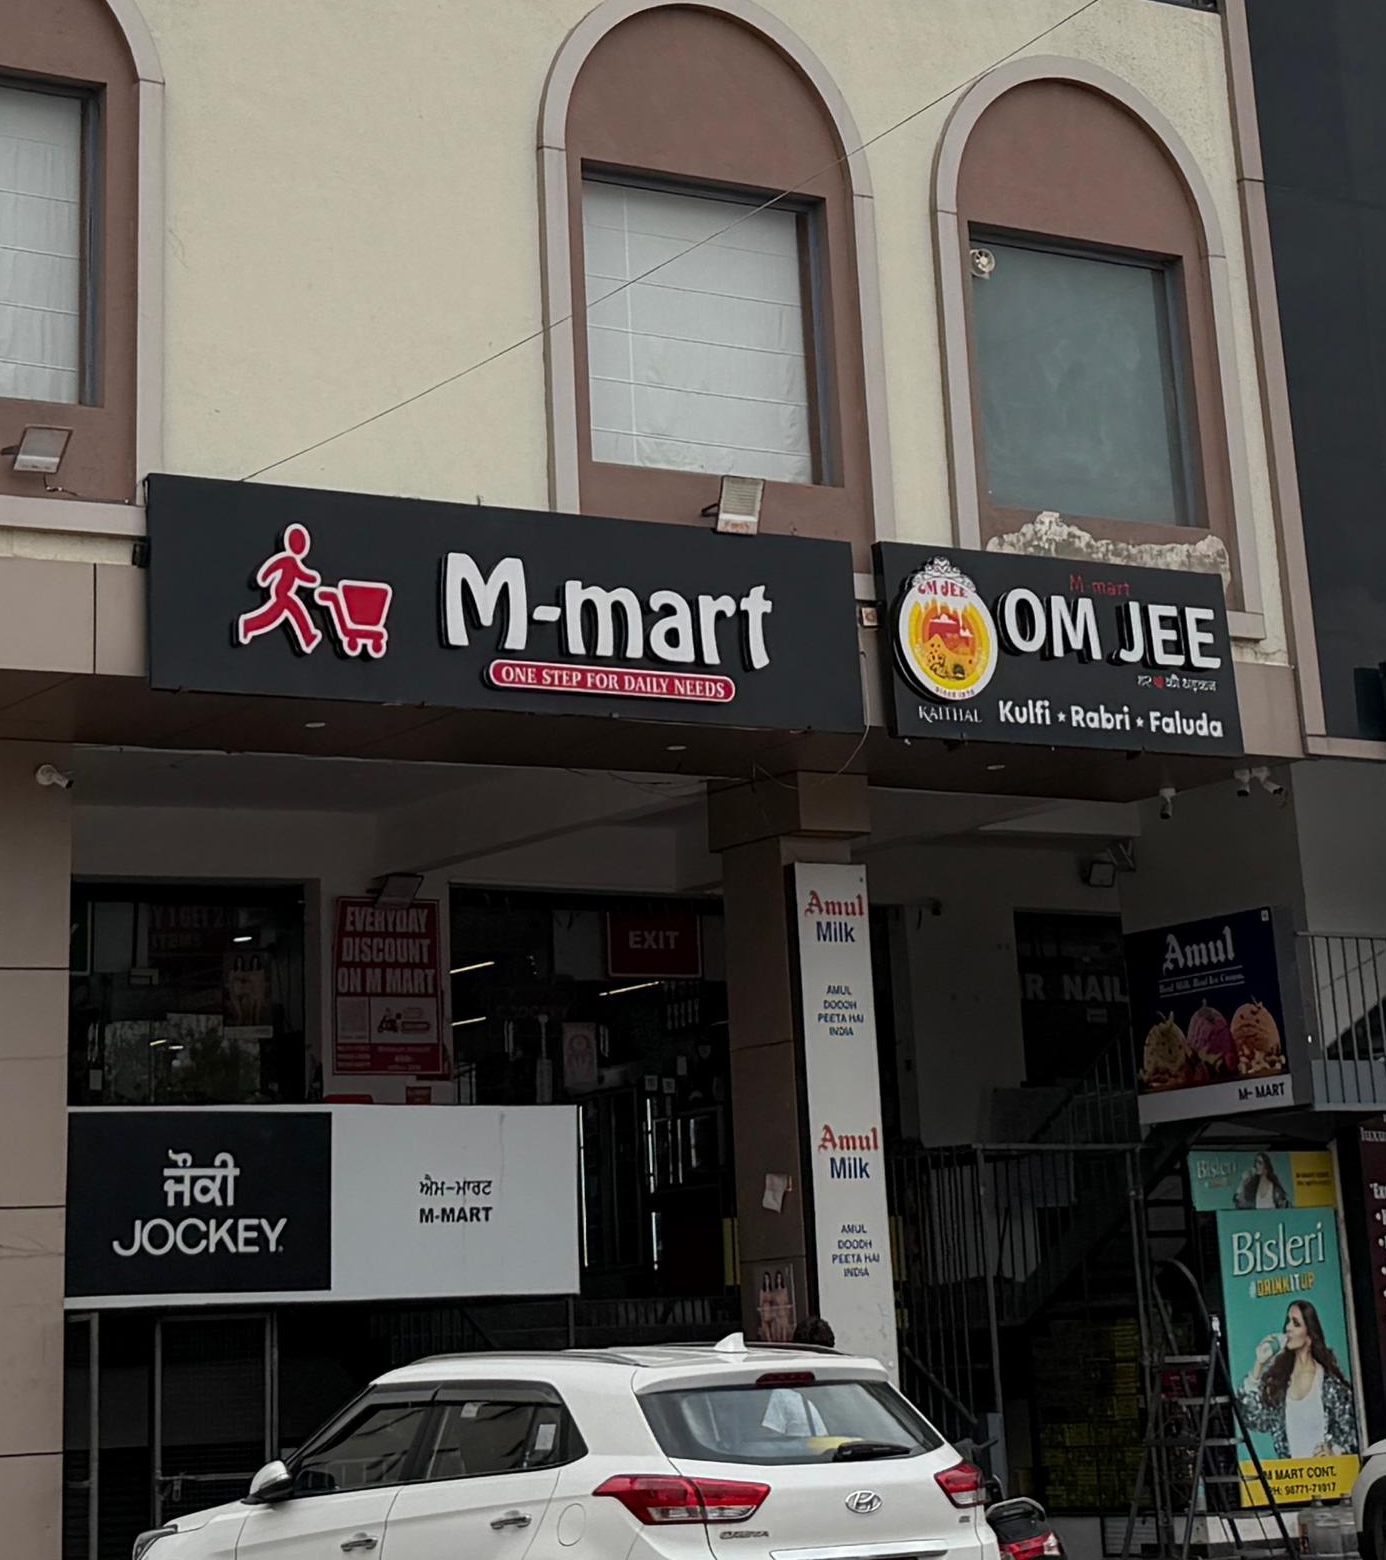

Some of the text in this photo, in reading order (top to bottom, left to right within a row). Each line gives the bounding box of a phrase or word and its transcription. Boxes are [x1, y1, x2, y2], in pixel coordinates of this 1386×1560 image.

[443, 551, 773, 670] M-mart
[1003, 587, 1222, 669] OM JEE
[501, 665, 725, 698] ONE STEP FOR DAILY NEEDS
[918, 705, 983, 724] KAITHAL
[998, 698, 1224, 738] Kulfi Rabri Faluda
[805, 890, 865, 917] Amul
[344, 905, 429, 934] EVERYDAY
[816, 921, 855, 943] Milk
[340, 936, 431, 964] DISCOUNT
[627, 929, 680, 951] EXIT
[1161, 925, 1236, 977] Amul
[337, 967, 436, 995] ON M MART
[826, 985, 852, 996] AMUL
[1062, 973, 1130, 1003] NAIL
[818, 1013, 864, 1024] PEETA HAI
[829, 1027, 854, 1037] INDIA
[818, 1124, 879, 1152] Amul
[830, 1157, 871, 1179] Milk
[112, 1217, 288, 1257] JOCKEY
[841, 1224, 867, 1234] AMUL
[832, 1254, 880, 1265] PEETA HAI
[1231, 1221, 1324, 1276] Bisleri
[843, 1267, 870, 1278] INDIA
[1274, 1467, 1305, 1481] MART
[1307, 1465, 1337, 1479] CONT.
